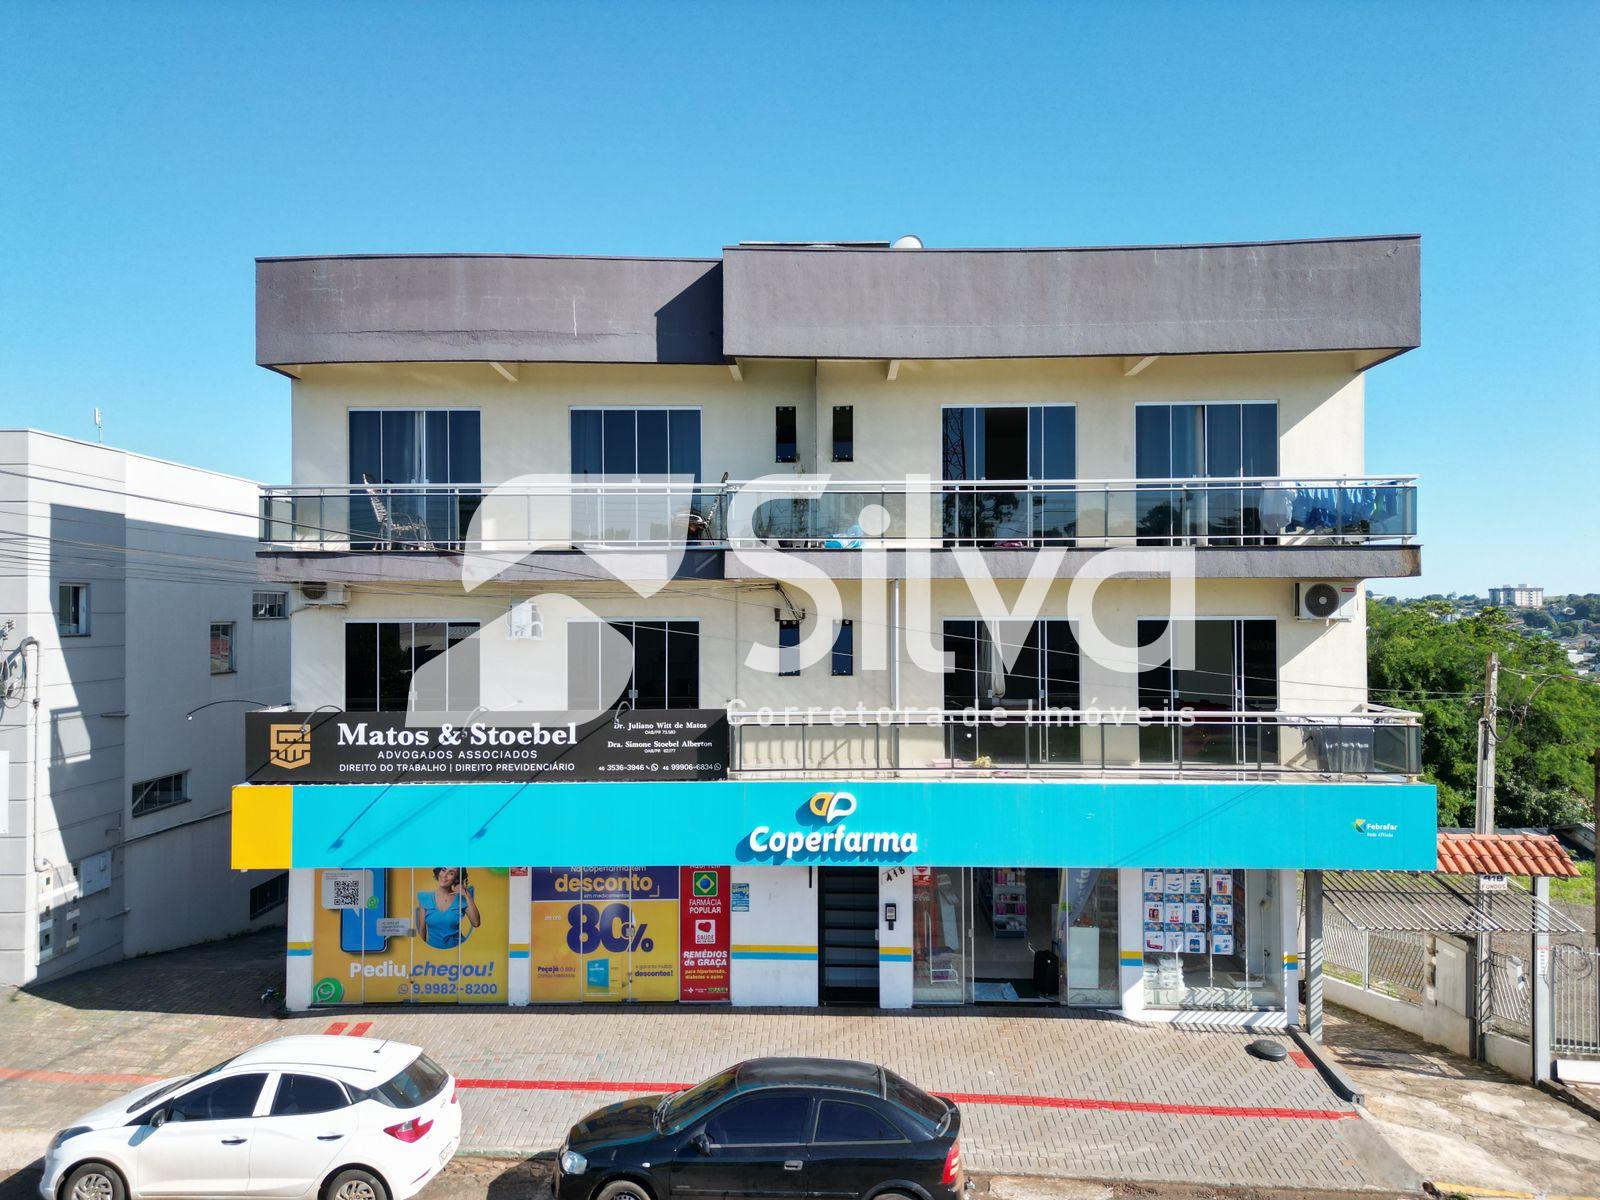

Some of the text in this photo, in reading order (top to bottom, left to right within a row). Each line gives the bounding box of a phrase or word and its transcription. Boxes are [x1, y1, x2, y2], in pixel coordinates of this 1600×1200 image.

[627, 722, 654, 731] Juliano
[337, 722, 578, 746] Matos & Stoebel
[377, 750, 538, 760] ADVOGADOS ASSOCIADOS
[339, 763, 377, 772] DIREITO
[380, 763, 394, 772] DO
[397, 763, 447, 772] TRABALHO
[455, 763, 493, 772] DIREITO
[496, 761, 575, 772] PREVIDENCIÁRIO
[671, 763, 713, 771] 99906-6834
[1366, 823, 1398, 831] Febrafar
[750, 825, 919, 859] Coperfarma
[555, 874, 653, 892] desconto
[689, 898, 722, 906] FARMÁCIA
[689, 906, 722, 914] POPULAR
[683, 949, 728, 958] REMÉDIOS
[697, 959, 727, 967] GRAÇA
[350, 961, 495, 981] Pediu, chegou!
